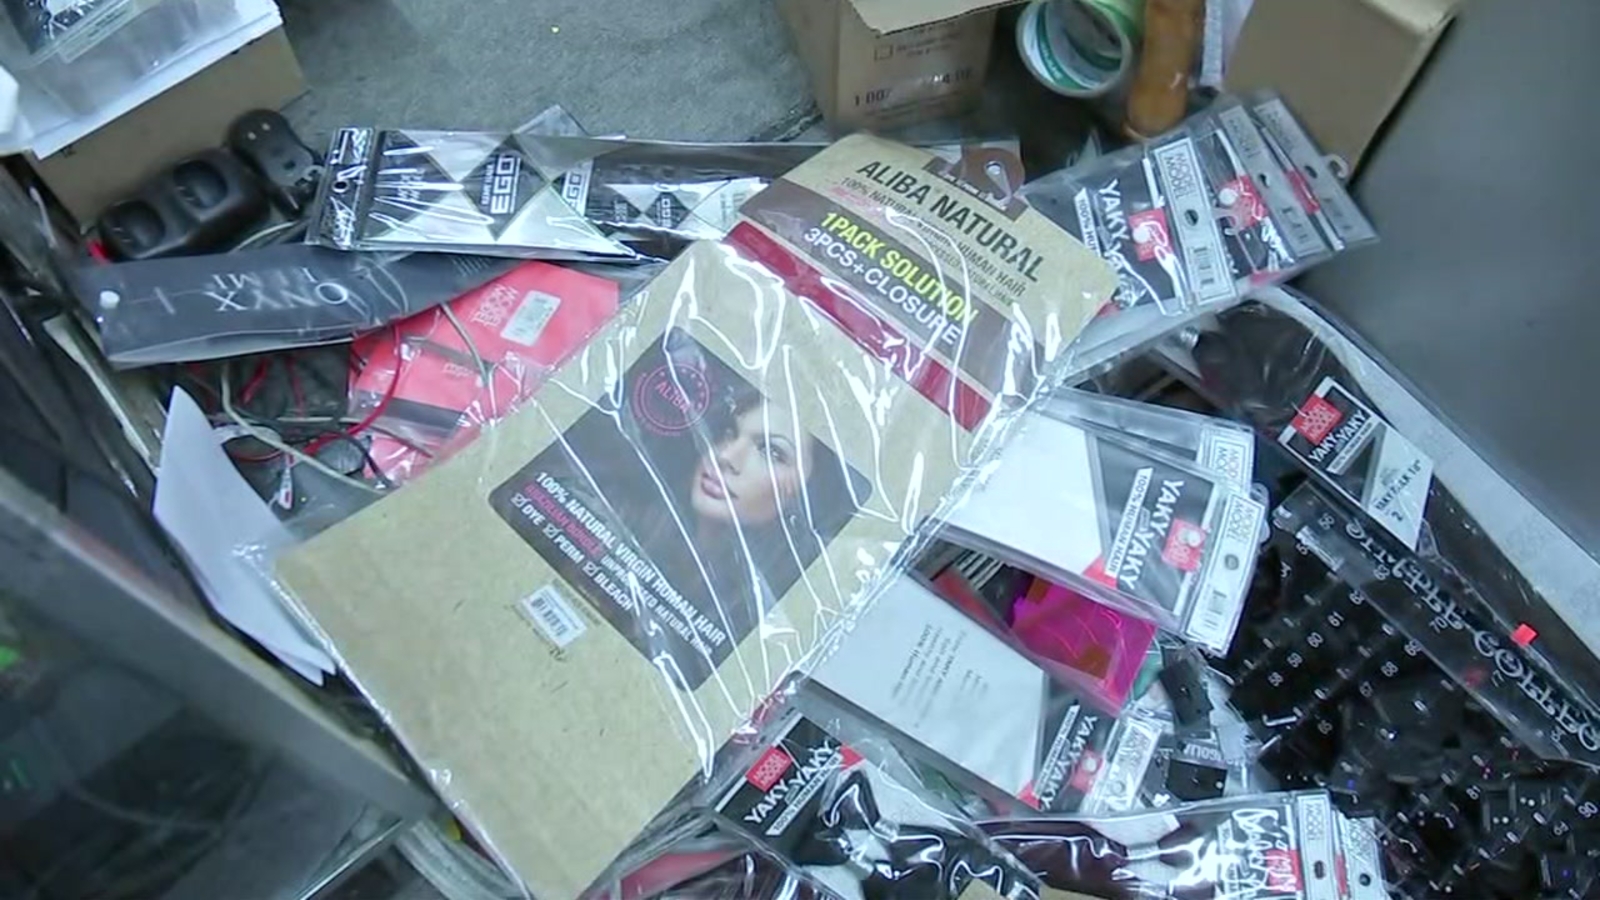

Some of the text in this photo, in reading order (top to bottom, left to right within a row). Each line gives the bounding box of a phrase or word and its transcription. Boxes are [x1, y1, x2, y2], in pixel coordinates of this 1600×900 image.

[490, 155, 514, 215] EGO
[1162, 154, 1187, 199] MODEL
[855, 162, 933, 206] ALIBA
[928, 192, 1045, 283] NATURAL
[1097, 178, 1129, 239] YAKY
[201, 280, 348, 314] ONYX
[802, 227, 964, 345] 3PCS+CLOSURE
[818, 212, 978, 328] 1PACK SOLUTION
[1309, 409, 1366, 463] YAKY YAKY
[1107, 473, 1147, 573] 100% HUMAN HAIR
[1148, 480, 1183, 537] YAKY
[520, 503, 635, 612] DYE PERM BLEACH
[534, 469, 727, 647] 100% NATURAL VIRGIN HUMAN HAIR
[1118, 531, 1153, 589] YAKY
[653, 602, 694, 641] NATURAL
[1307, 632, 1324, 648] 60
[1328, 611, 1344, 627] 61
[1268, 672, 1284, 687] 58
[1287, 652, 1303, 668] 59
[1381, 662, 1399, 677] 68
[744, 740, 833, 823] YAKY YAKY
[1039, 715, 1097, 809] YAKY YAKY
[1578, 801, 1598, 818] 90
